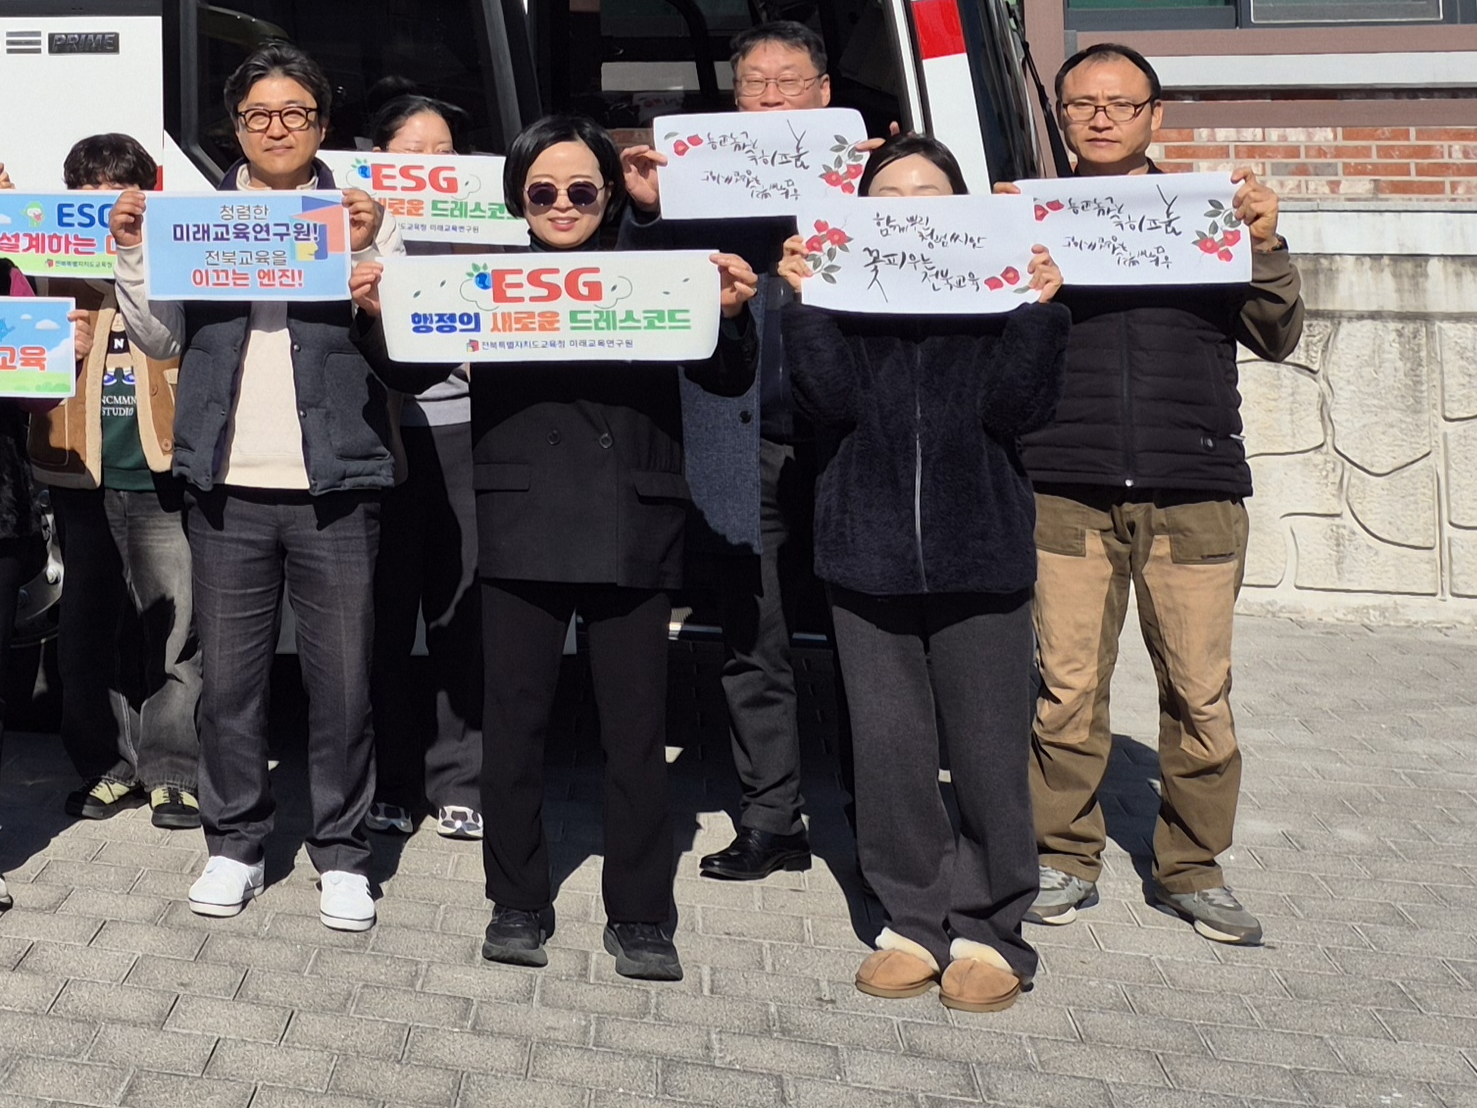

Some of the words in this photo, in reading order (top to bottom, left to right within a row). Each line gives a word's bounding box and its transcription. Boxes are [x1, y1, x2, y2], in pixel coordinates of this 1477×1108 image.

[50, 33, 118, 51] PRIME
[371, 163, 459, 193] ESG
[220, 204, 270, 220] 청렴한
[173, 223, 319, 242] 미래교육연구원!
[205, 250, 288, 266] 전북교육을
[192, 268, 250, 287] 이끄는
[257, 269, 303, 288] 엔진!
[491, 267, 603, 303] ESG
[411, 311, 482, 334] 행정의
[490, 311, 561, 333] 새로운
[569, 309, 692, 332] 드레스코드
[113, 338, 125, 350] N
[481, 339, 566, 351] 전북특별자치도교육청
[569, 339, 634, 349] 미래교육연구원
